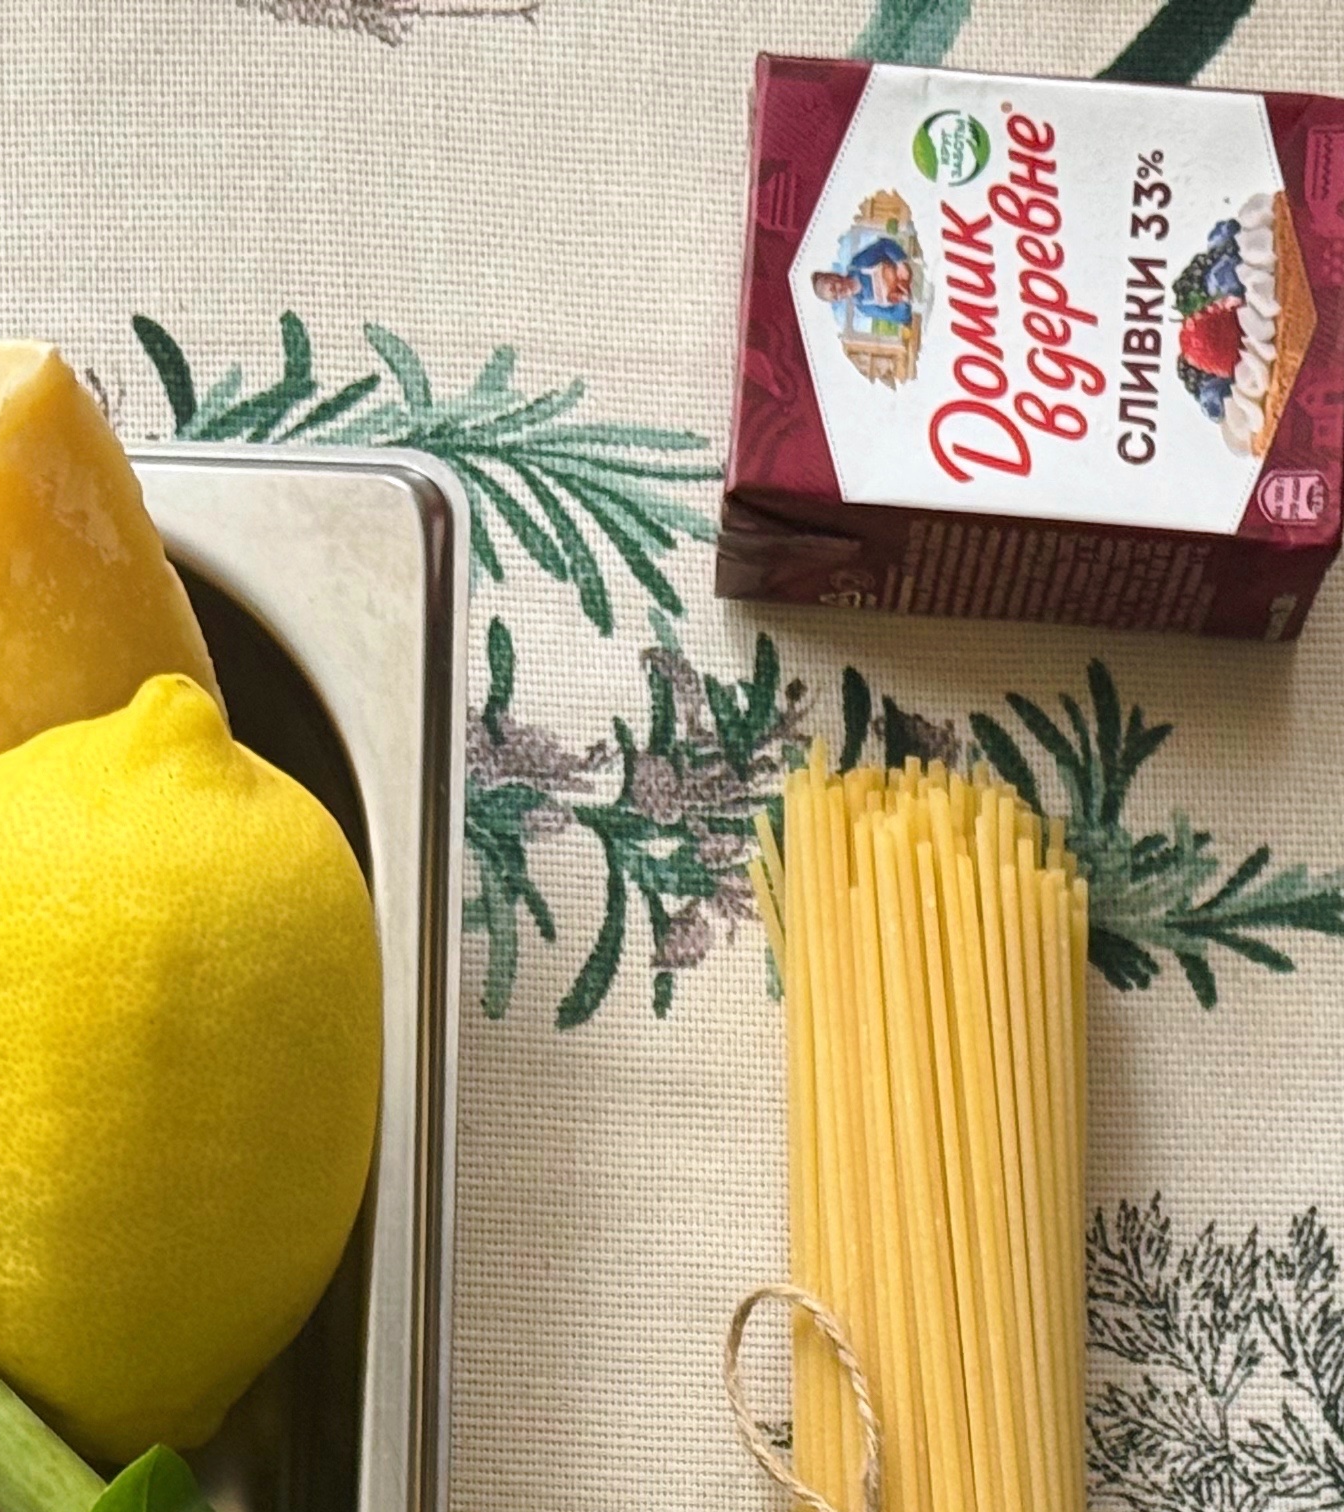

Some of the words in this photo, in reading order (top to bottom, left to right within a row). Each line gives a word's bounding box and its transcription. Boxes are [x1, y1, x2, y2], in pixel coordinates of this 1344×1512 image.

[987, 112, 1107, 398] деревне
[1130, 148, 1173, 242] 33%
[928, 200, 1032, 484] Домик
[1013, 391, 1090, 442] в
[1116, 258, 1168, 466] СЛИВКИ
